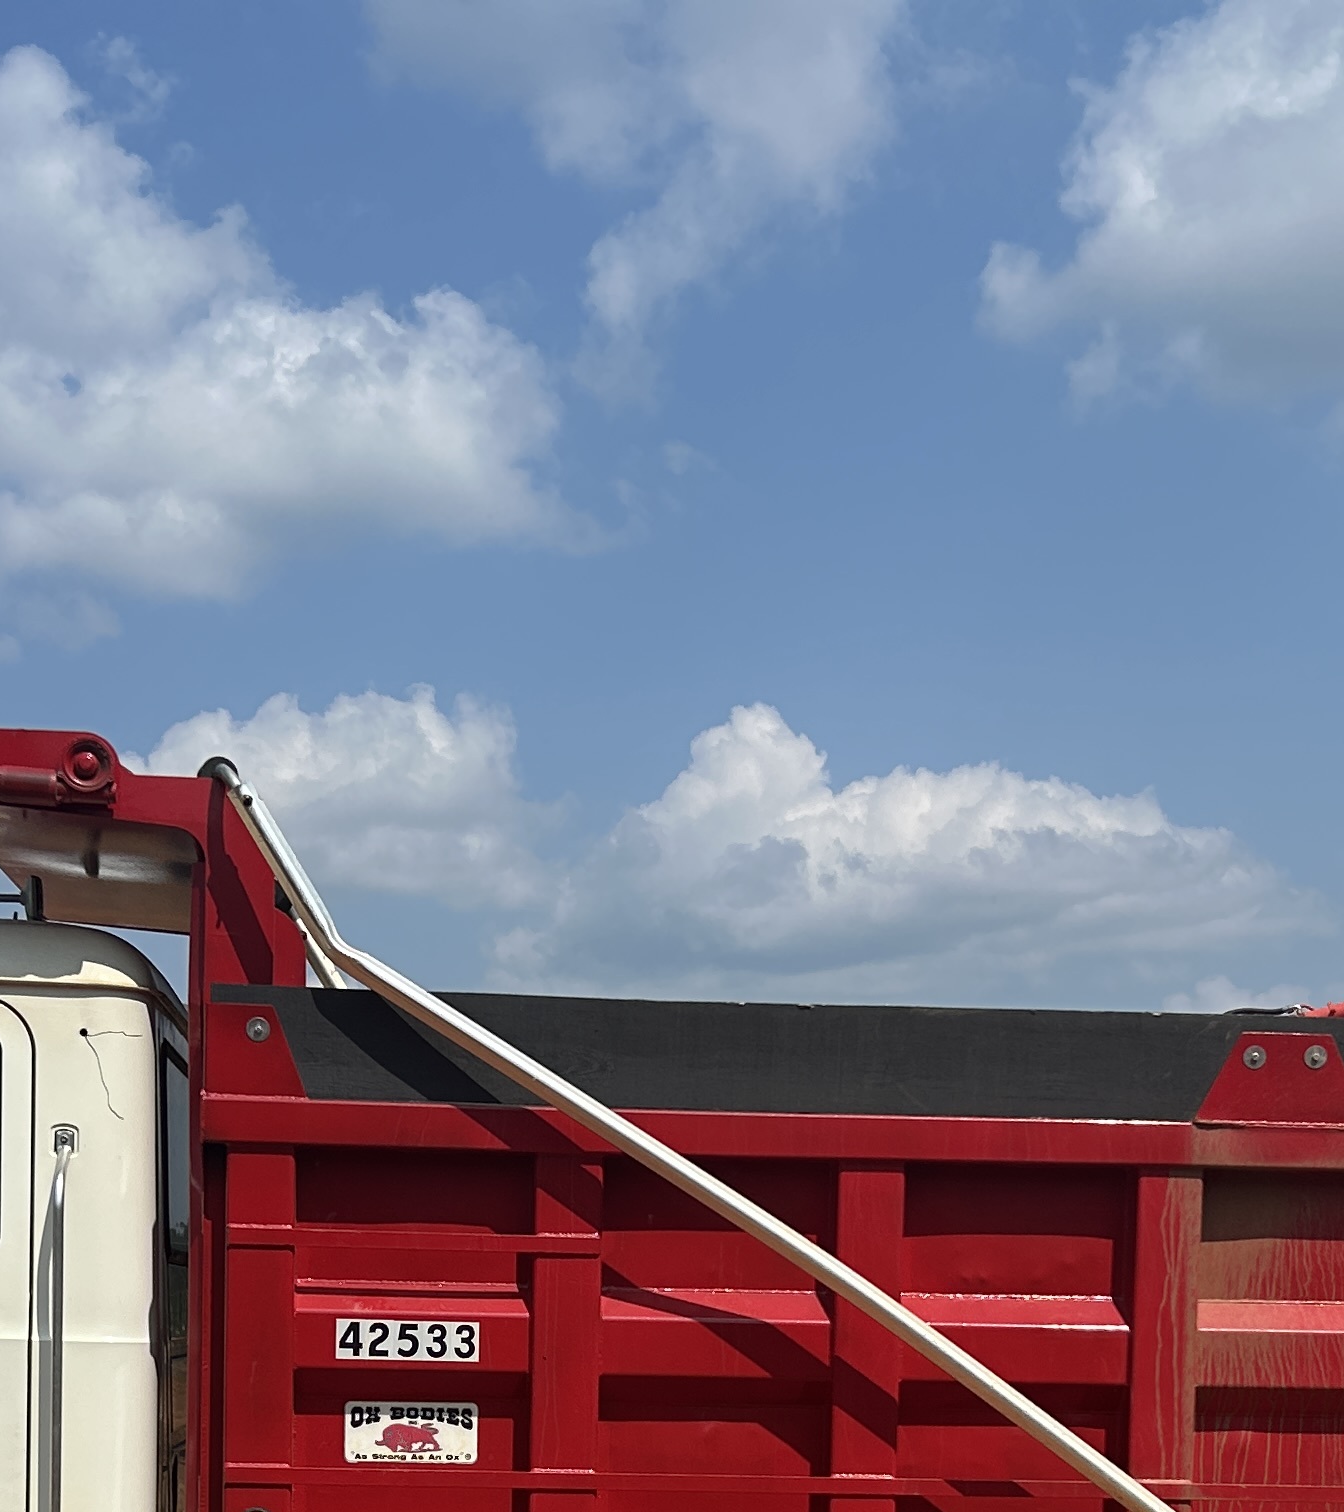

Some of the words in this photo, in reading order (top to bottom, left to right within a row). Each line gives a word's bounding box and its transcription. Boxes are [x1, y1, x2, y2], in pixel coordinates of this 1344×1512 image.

[338, 1321, 476, 1359] 42533
[350, 1406, 381, 1429] OX
[389, 1406, 474, 1430] BODIES
[372, 1453, 407, 1461] Strong
[428, 1453, 442, 1461] An
